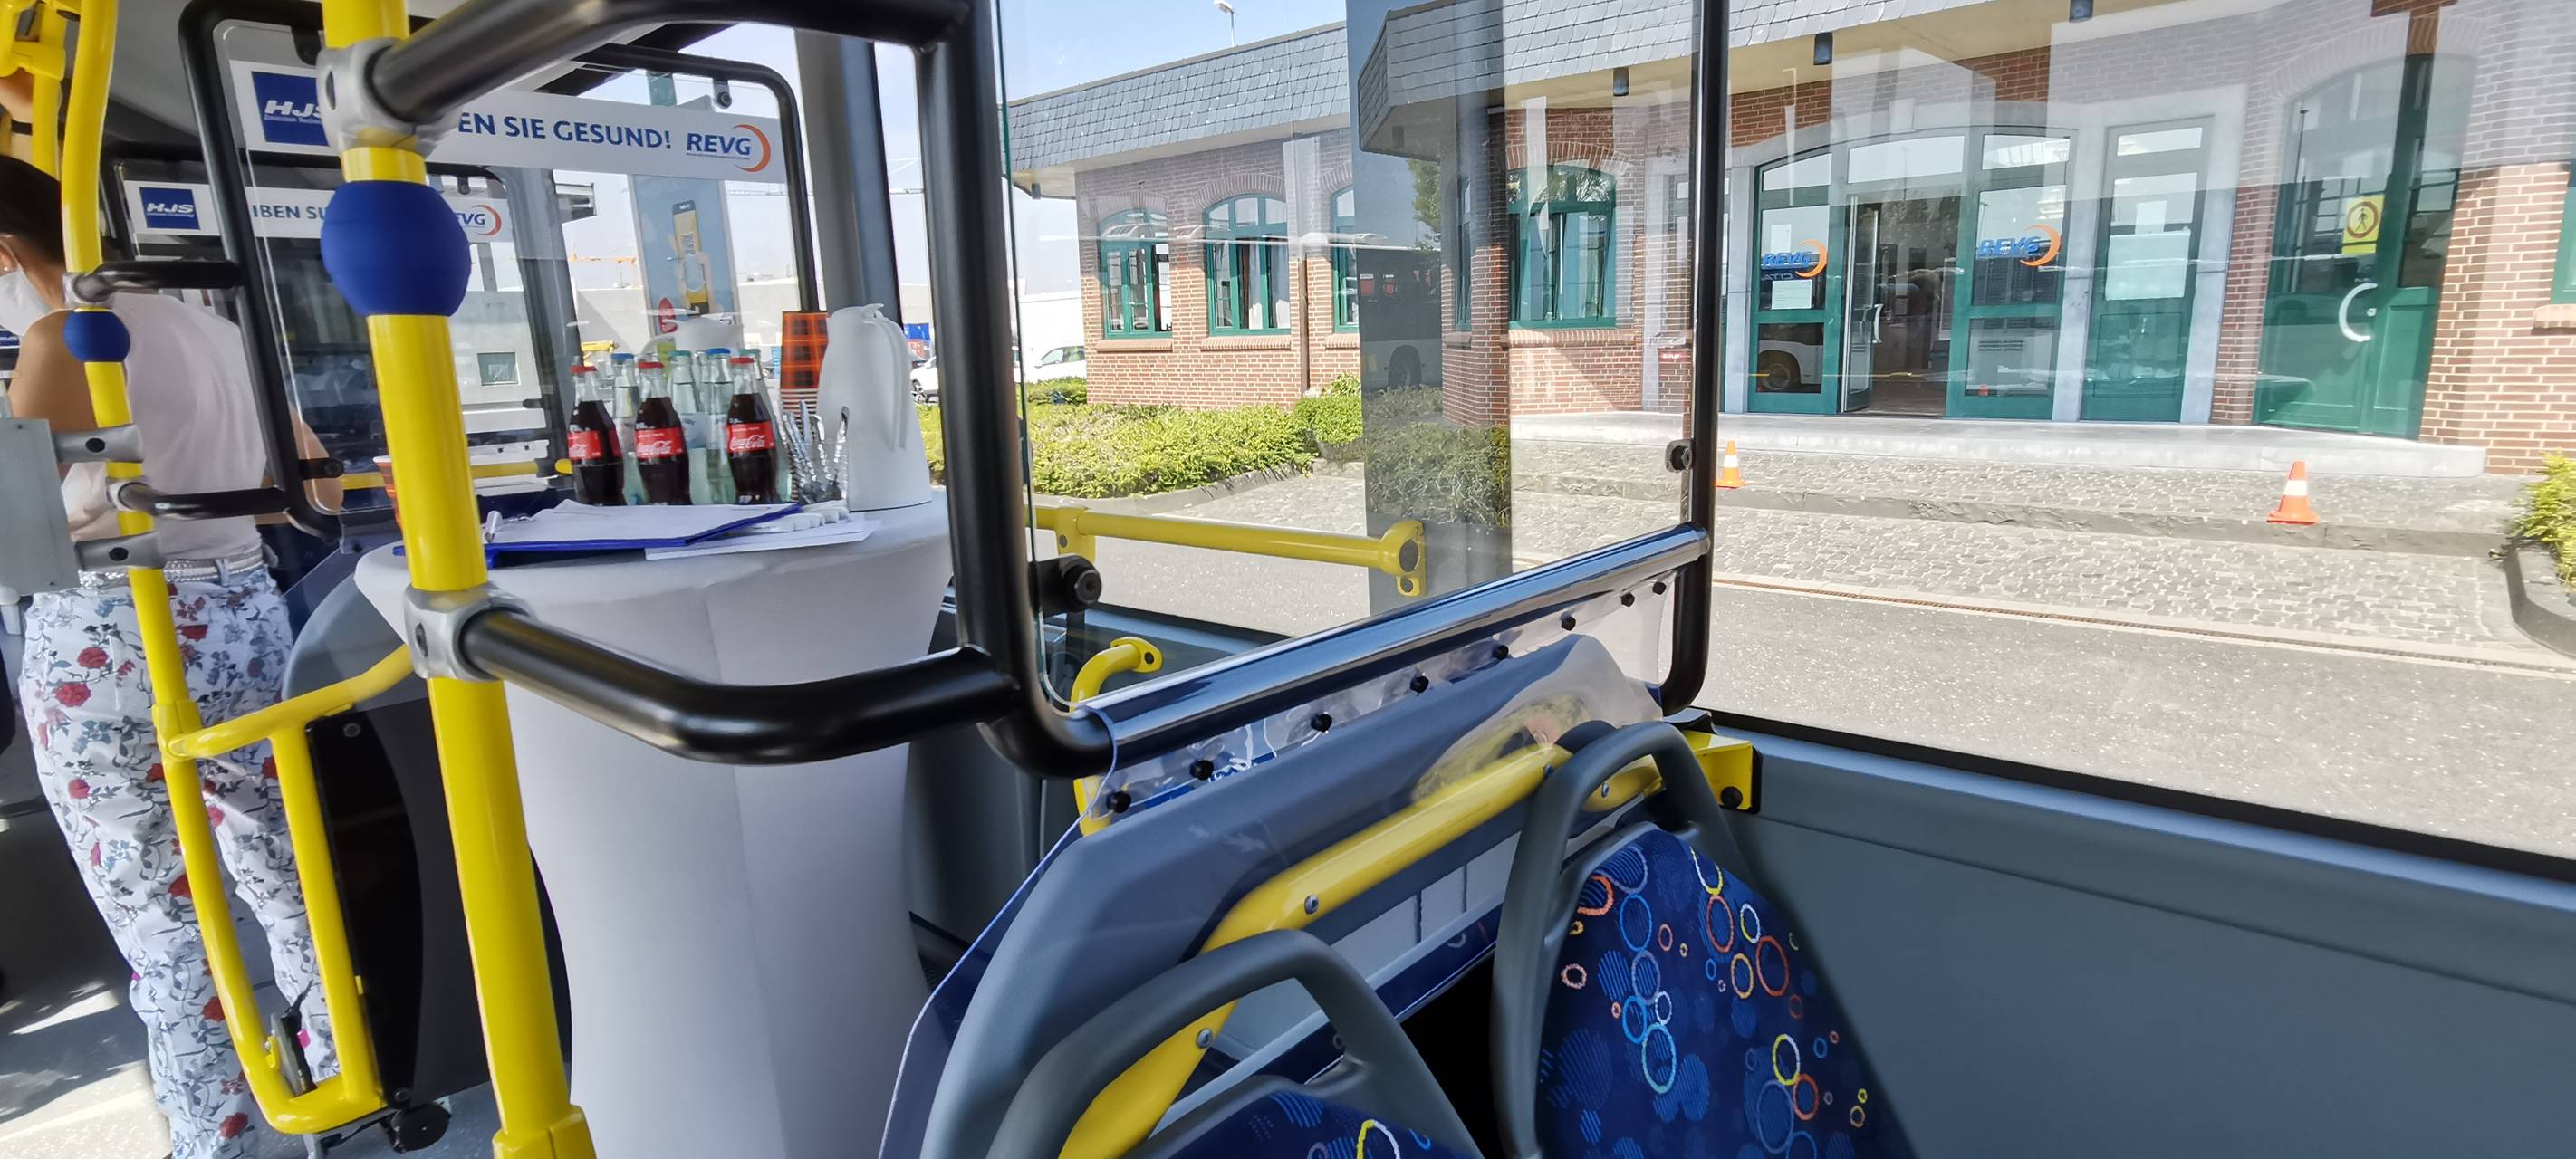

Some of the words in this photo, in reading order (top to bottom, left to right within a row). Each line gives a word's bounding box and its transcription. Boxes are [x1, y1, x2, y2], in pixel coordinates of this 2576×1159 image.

[504, 116, 546, 139] SIE
[553, 120, 672, 149] GESUND!
[687, 132, 751, 155] REVG
[147, 203, 195, 214] HJS
[1978, 236, 2041, 259] REVG
[1762, 251, 1812, 269] REVG
